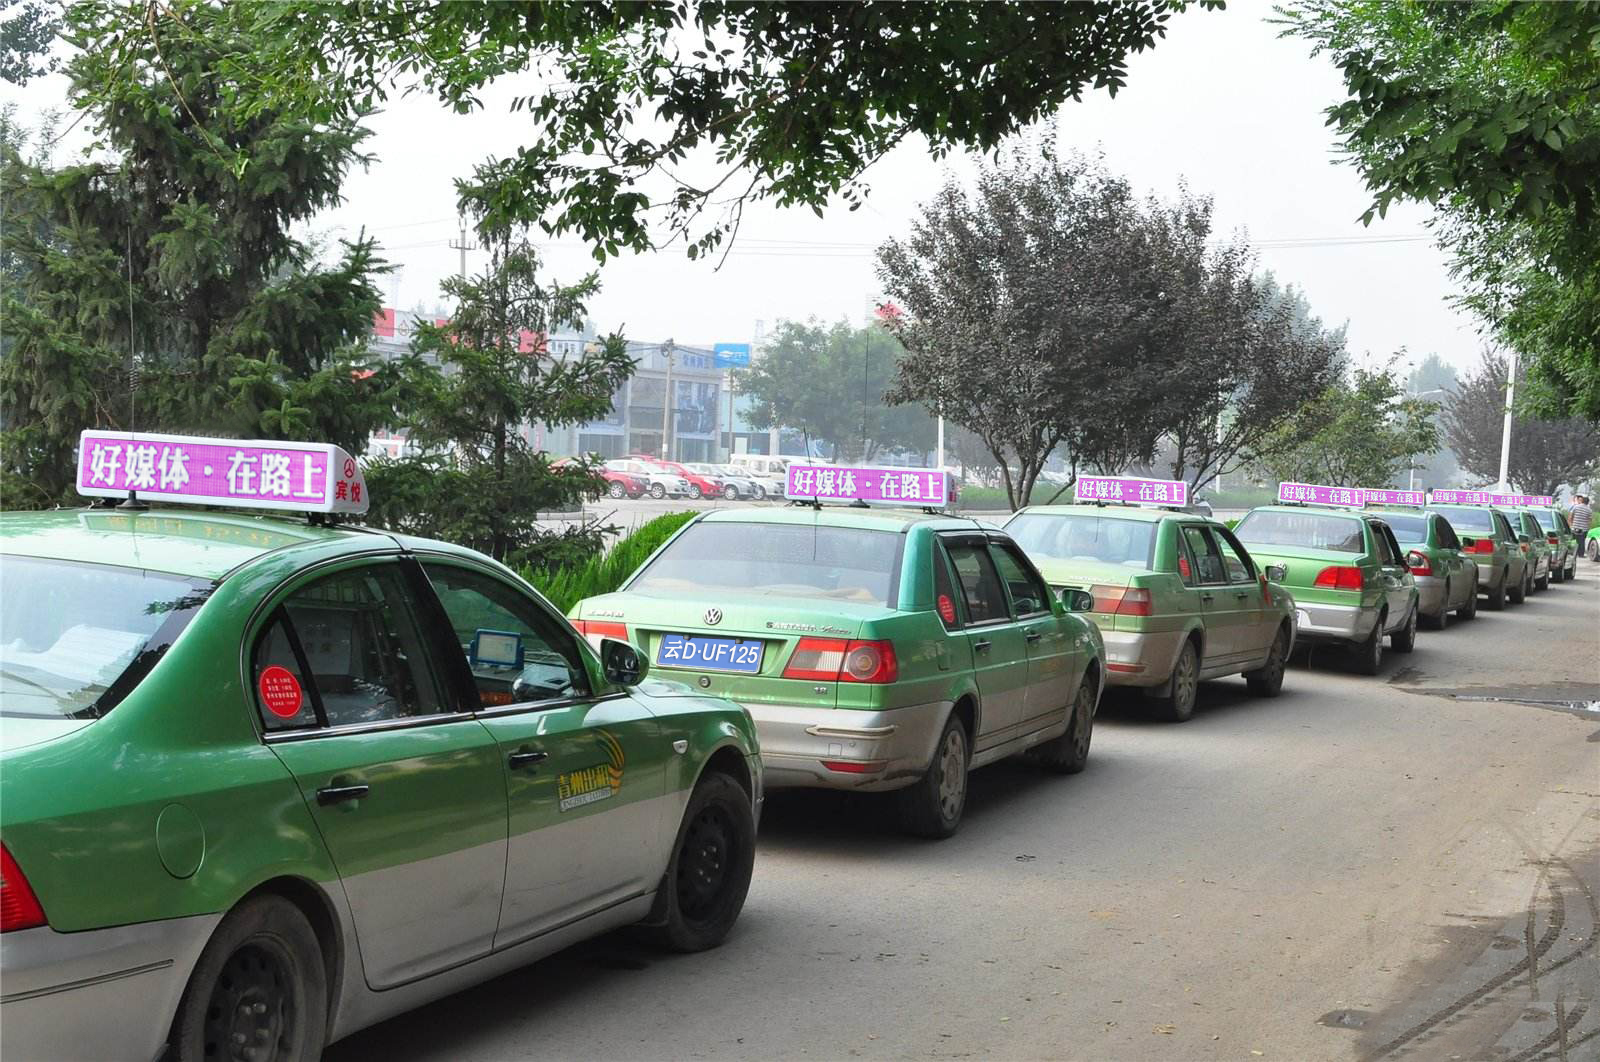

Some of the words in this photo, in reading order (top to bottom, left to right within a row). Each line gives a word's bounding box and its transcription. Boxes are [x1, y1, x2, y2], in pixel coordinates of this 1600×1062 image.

[89, 442, 325, 499] 好媒体·在路上
[335, 480, 361, 503] 宾悦
[793, 468, 943, 502] 好媒体·在路上
[1081, 480, 1184, 503] 好媒体·在路上
[1283, 485, 1363, 506] 好媒体·在路上
